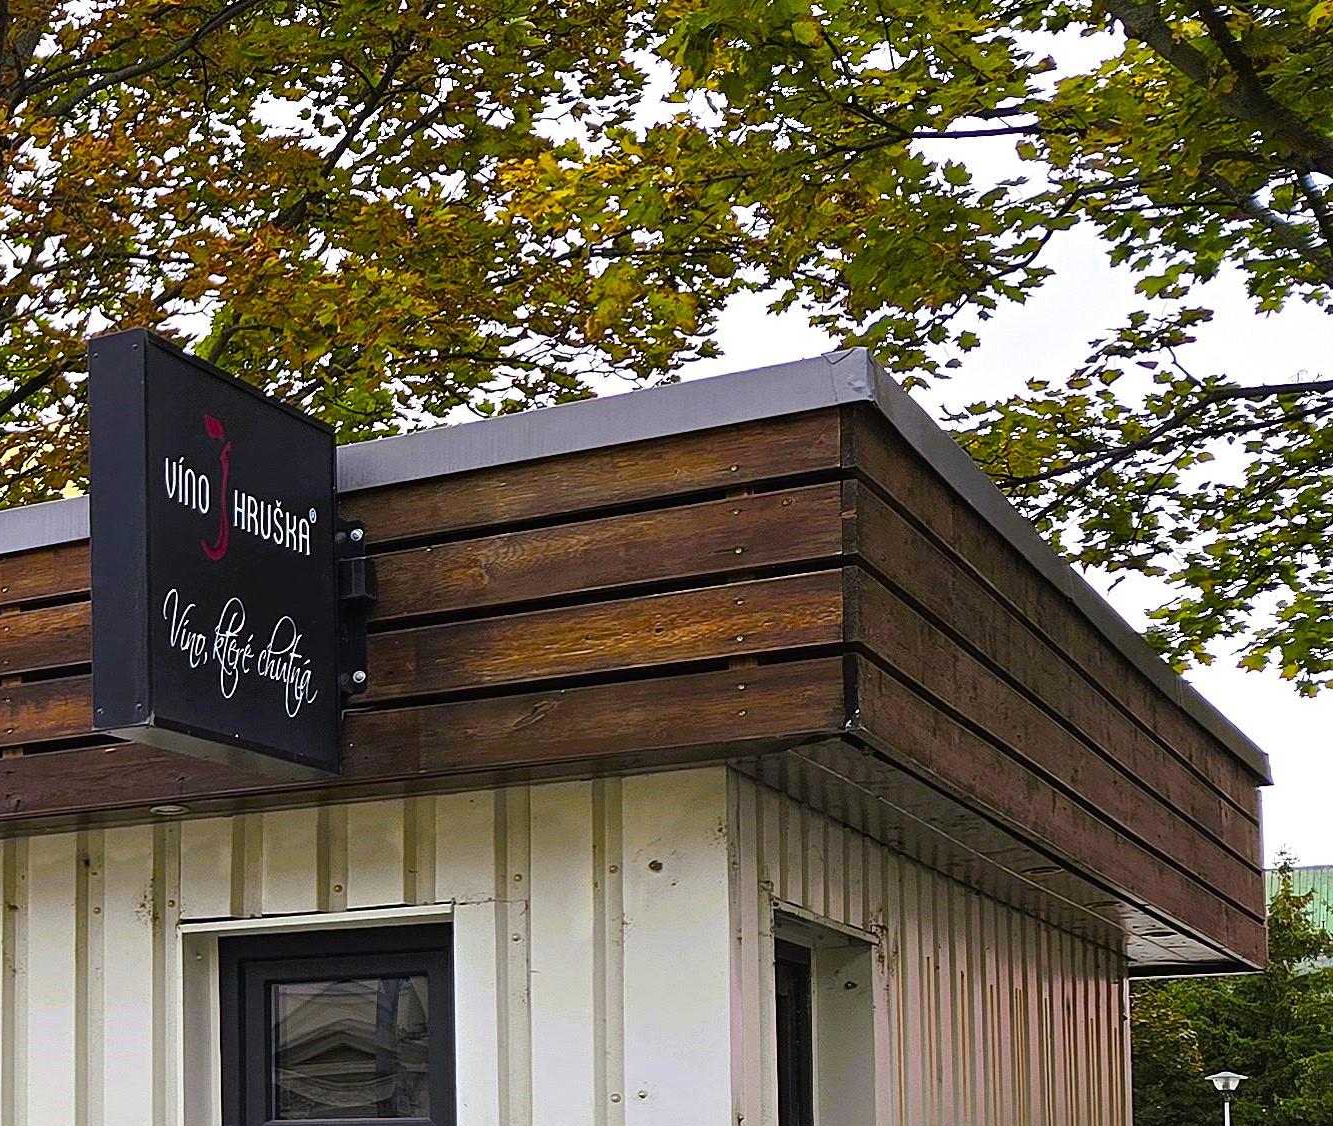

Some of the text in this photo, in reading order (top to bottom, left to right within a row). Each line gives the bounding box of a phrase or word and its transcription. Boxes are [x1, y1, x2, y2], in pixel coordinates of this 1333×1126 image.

[164, 456, 210, 515] VÍNO
[162, 587, 319, 718] Víno, které chutná
